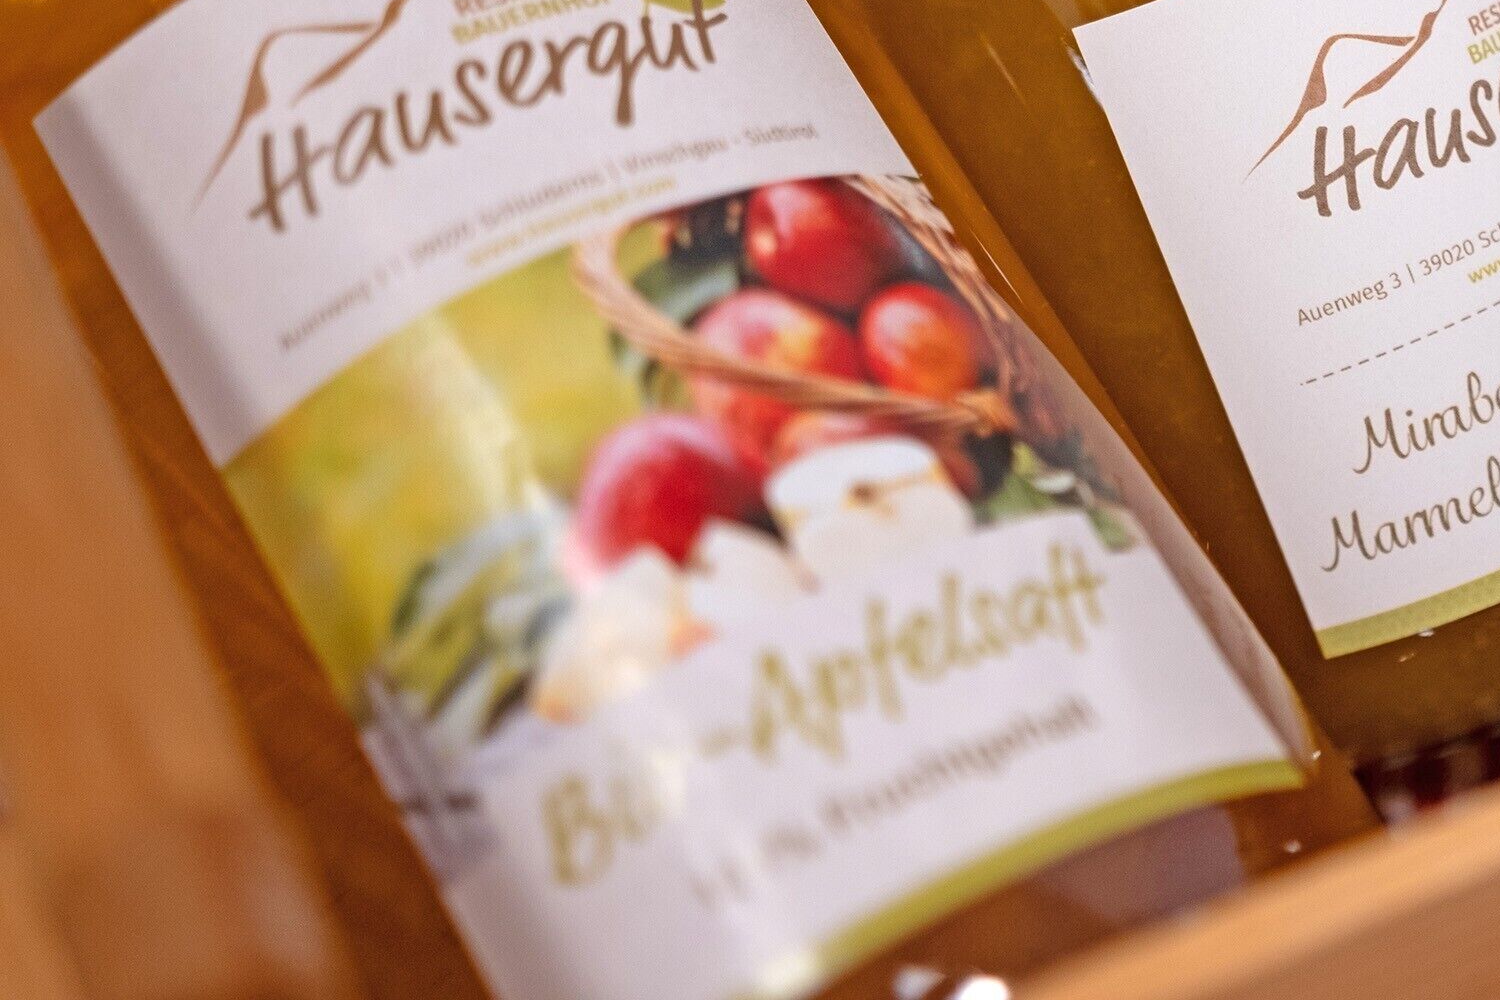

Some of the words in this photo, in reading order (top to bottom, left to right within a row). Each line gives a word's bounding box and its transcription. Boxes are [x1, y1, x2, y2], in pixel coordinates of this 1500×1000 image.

[1297, 281, 1388, 326] Auenweg
[1389, 271, 1404, 290] 3
[1418, 239, 1476, 277] 39020
